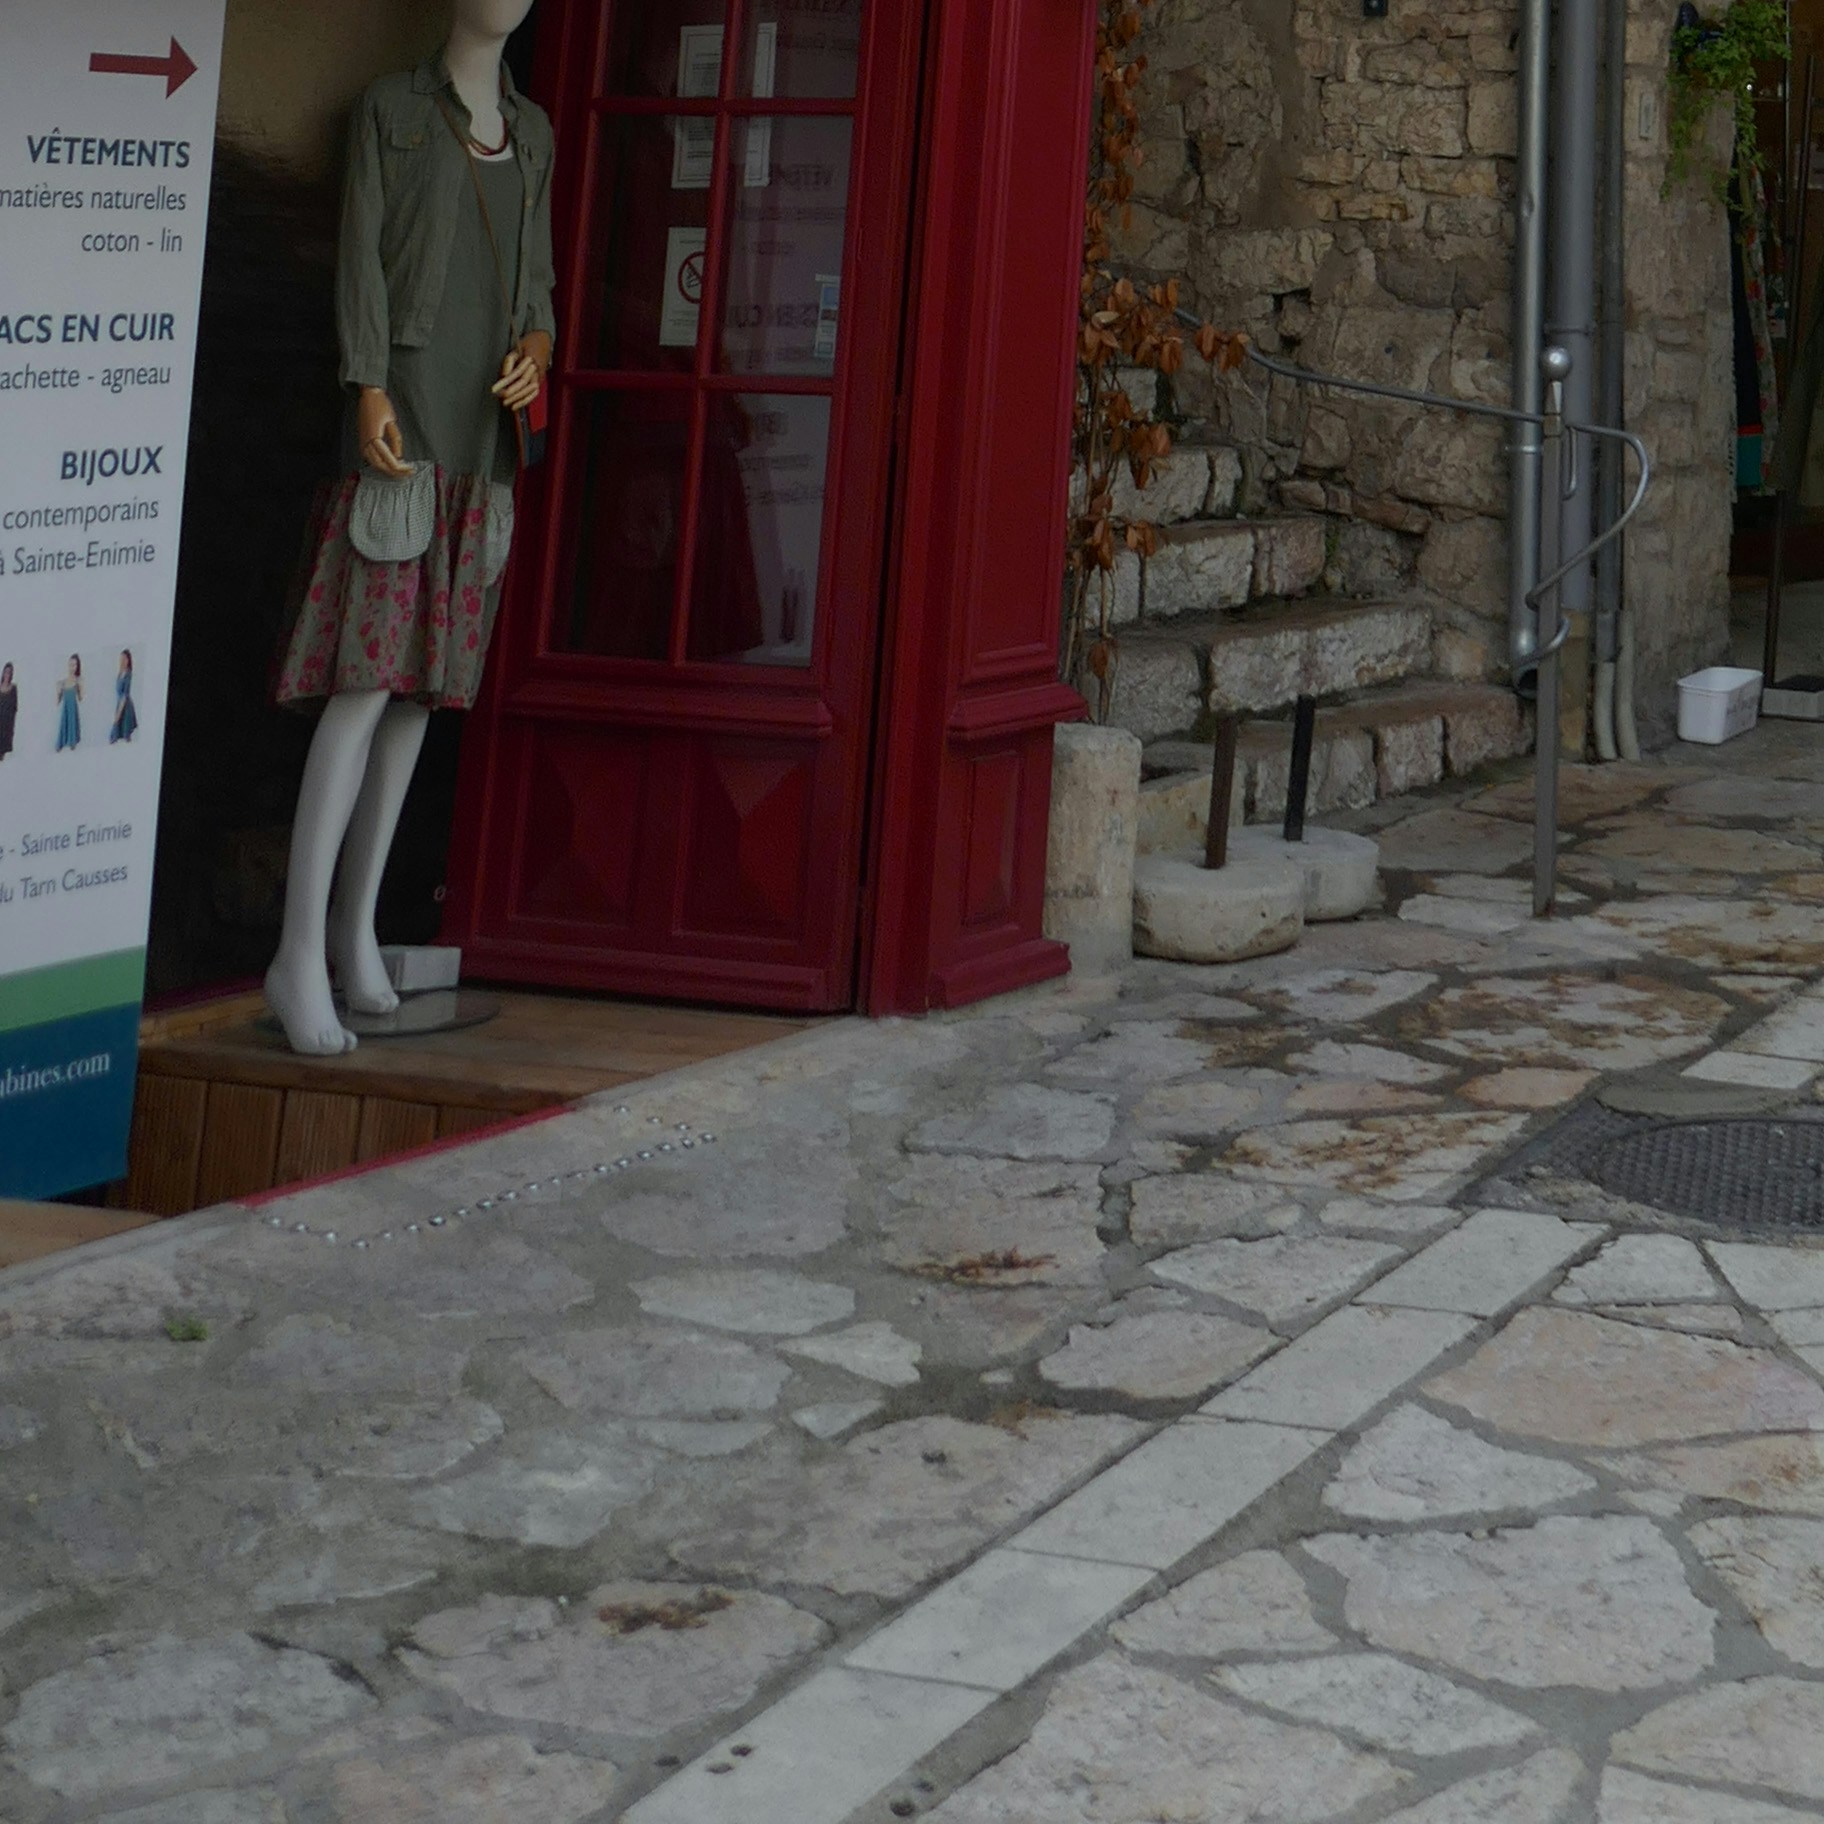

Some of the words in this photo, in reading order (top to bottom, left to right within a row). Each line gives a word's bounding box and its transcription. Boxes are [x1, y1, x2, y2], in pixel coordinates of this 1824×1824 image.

[26, 126, 191, 169] VÊTEMENTS
[90, 184, 187, 211] naturelles
[80, 230, 140, 253] coton
[159, 227, 183, 253] lin
[61, 313, 101, 343] EN
[108, 312, 176, 342] CUIR
[100, 365, 171, 394] agneau
[60, 445, 164, 486] BIJOUX
[3, 496, 159, 533] contemporains
[12, 539, 156, 576] Sainte-Enimie
[20, 832, 71, 857] Sainte
[75, 820, 134, 848] Enimie
[20, 875, 57, 900] Tarn
[62, 863, 129, 893] Causses
